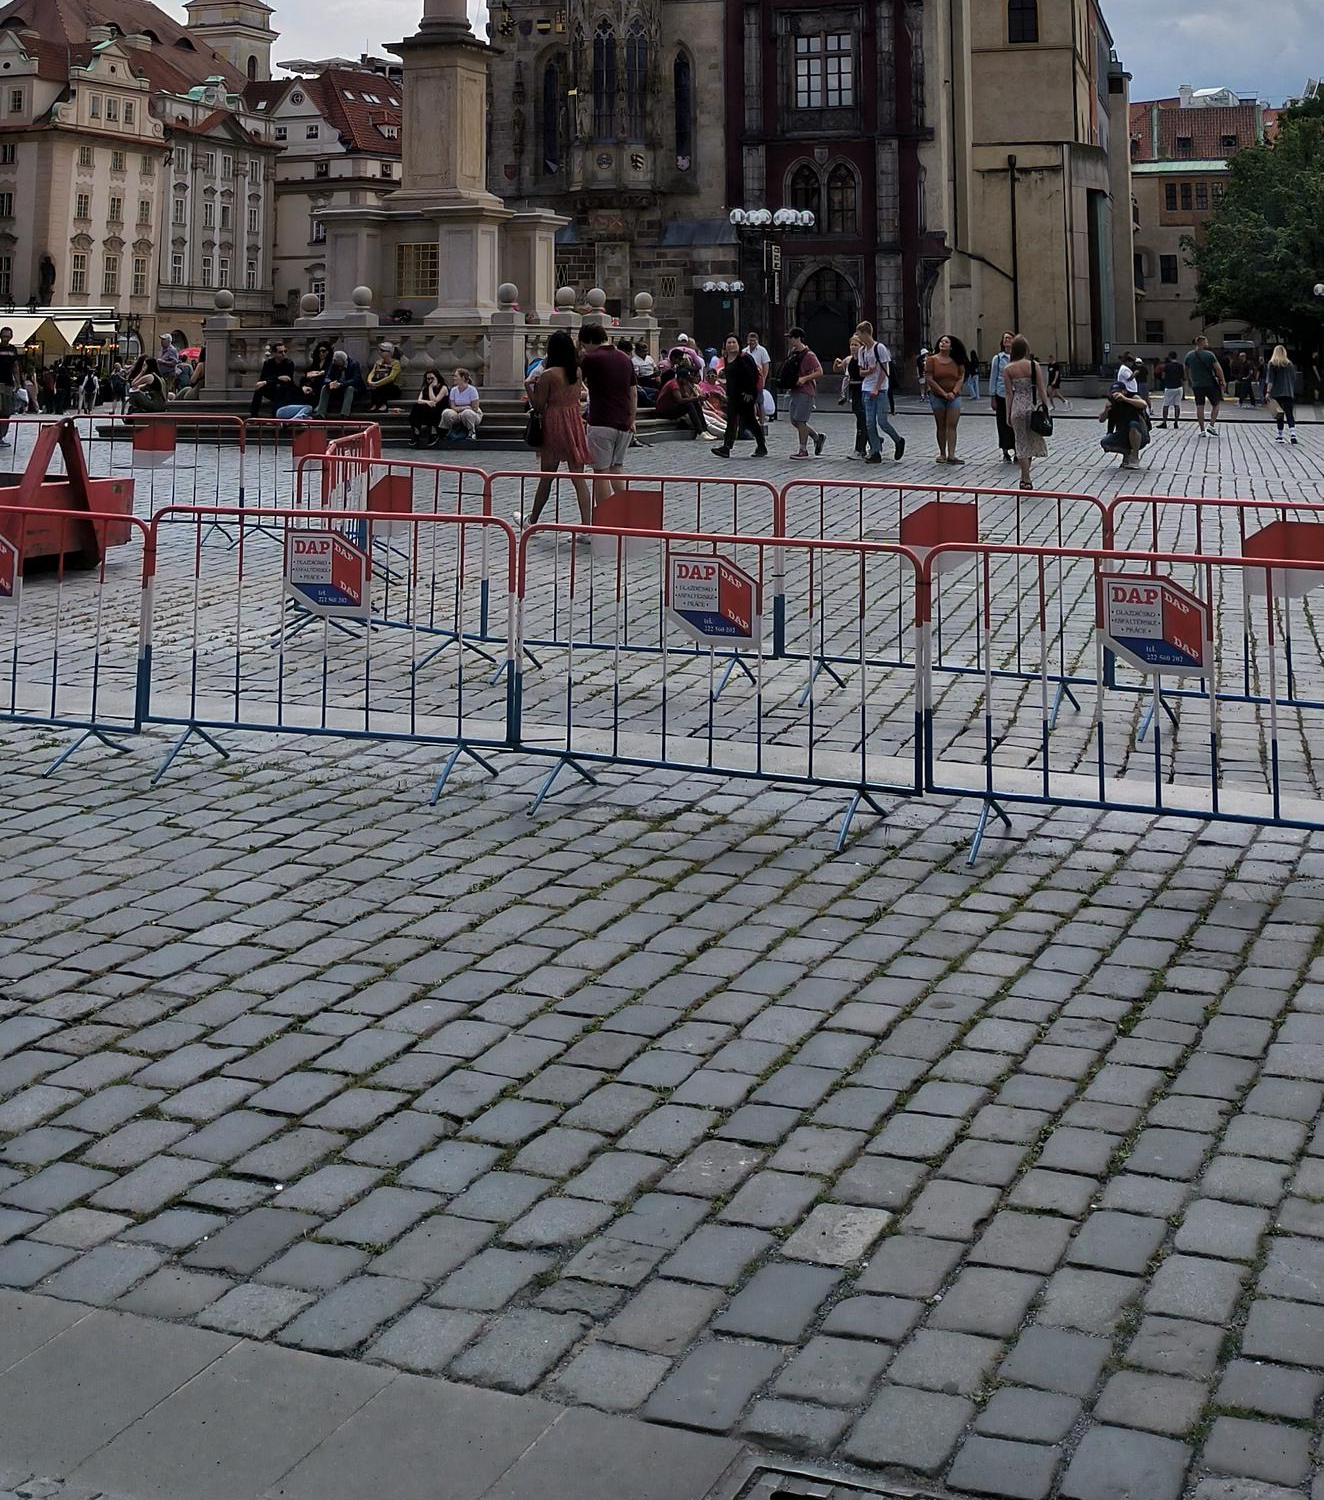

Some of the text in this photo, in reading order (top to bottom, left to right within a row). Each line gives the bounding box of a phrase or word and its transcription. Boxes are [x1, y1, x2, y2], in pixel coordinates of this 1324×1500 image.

[294, 540, 330, 555] DAP
[334, 543, 353, 561] DAP
[676, 564, 716, 580] DAP
[720, 568, 742, 588] DAP
[340, 581, 360, 599] DAP
[1112, 587, 1159, 605] DAP
[1164, 592, 1190, 614] DAP
[727, 609, 749, 629] DAP
[1173, 636, 1199, 660] DAP
